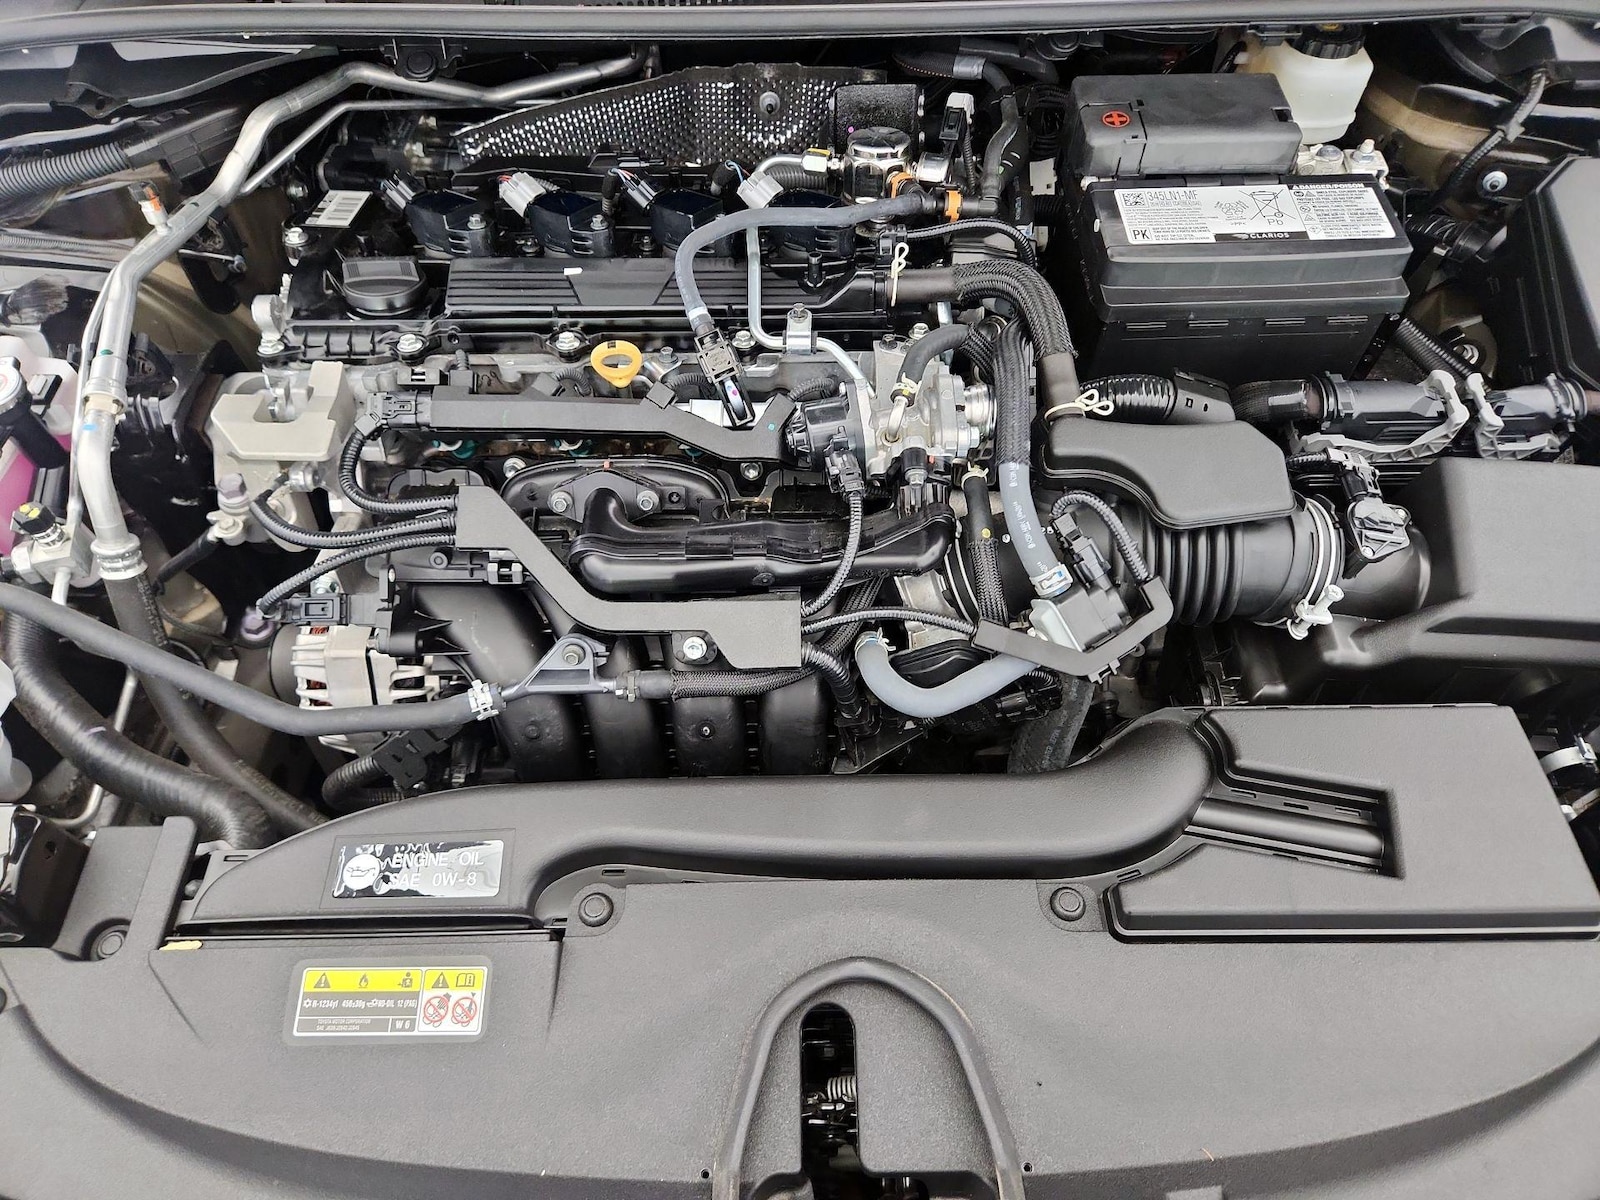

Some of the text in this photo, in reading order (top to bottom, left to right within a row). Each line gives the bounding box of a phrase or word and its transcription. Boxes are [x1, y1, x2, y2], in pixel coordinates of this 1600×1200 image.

[1147, 190, 1198, 201] 345LN1-MF
[1267, 218, 1284, 226] Pb
[1132, 229, 1150, 240] PK
[391, 851, 484, 869] ENGINE OIL
[389, 871, 477, 887] SAE 0W-8
[395, 1019, 404, 1029] W
